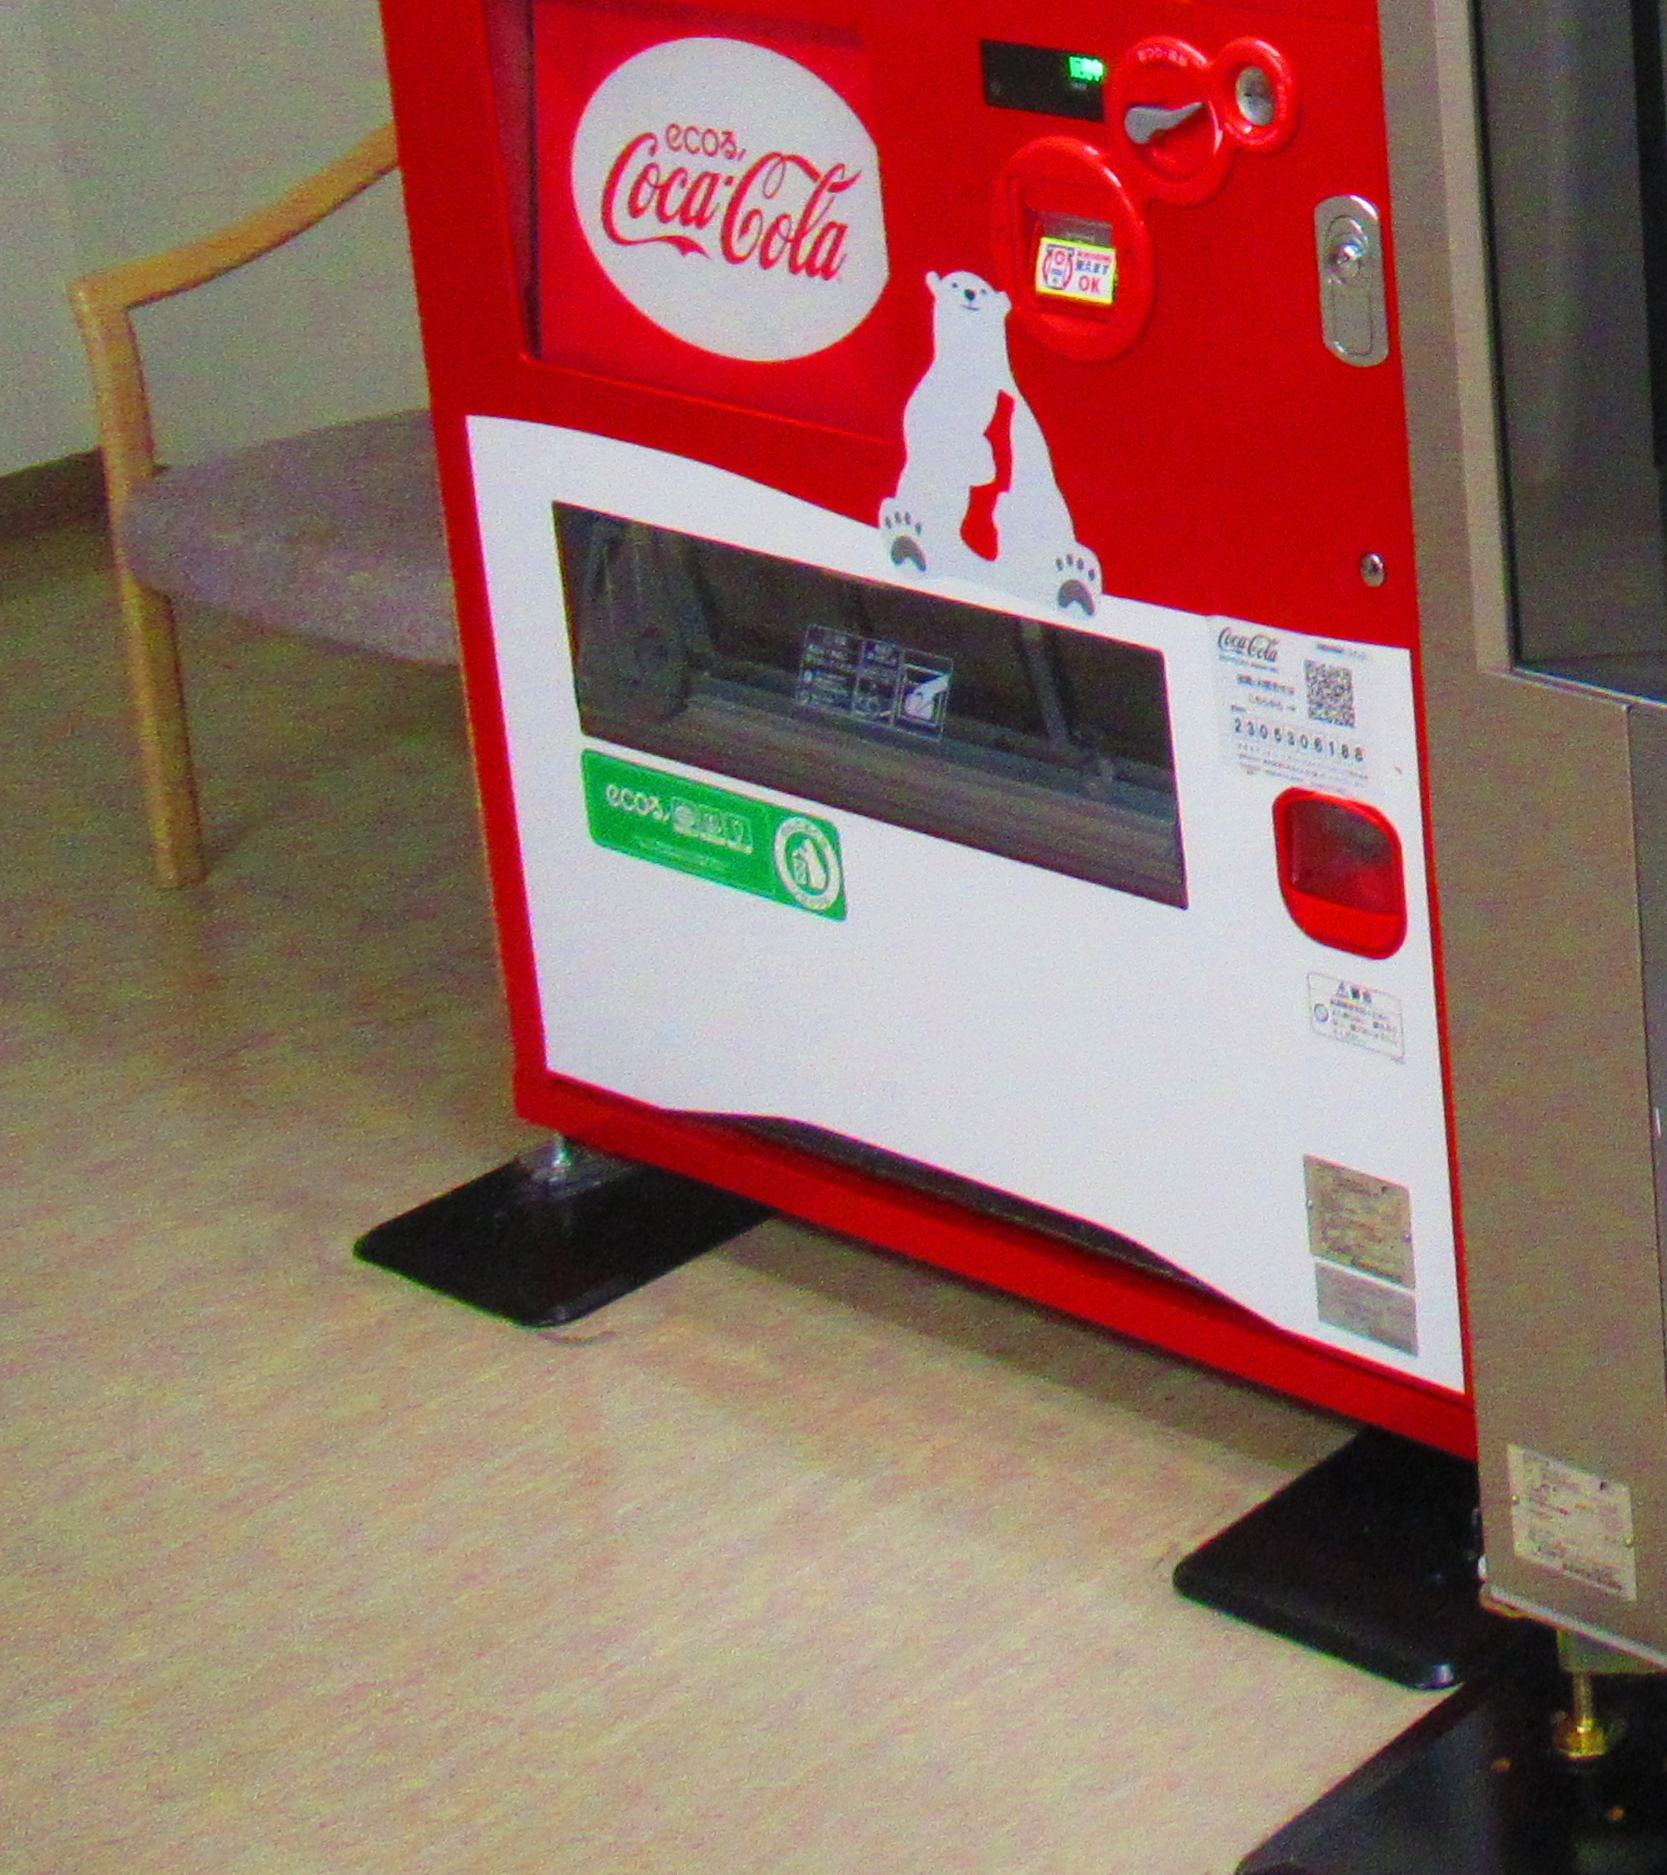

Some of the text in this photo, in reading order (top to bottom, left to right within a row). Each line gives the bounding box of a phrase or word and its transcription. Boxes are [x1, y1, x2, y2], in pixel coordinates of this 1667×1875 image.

[601, 131, 861, 281] Coca-Cola
[1078, 275, 1101, 293] OK
[1218, 627, 1280, 663] Coca-Cola
